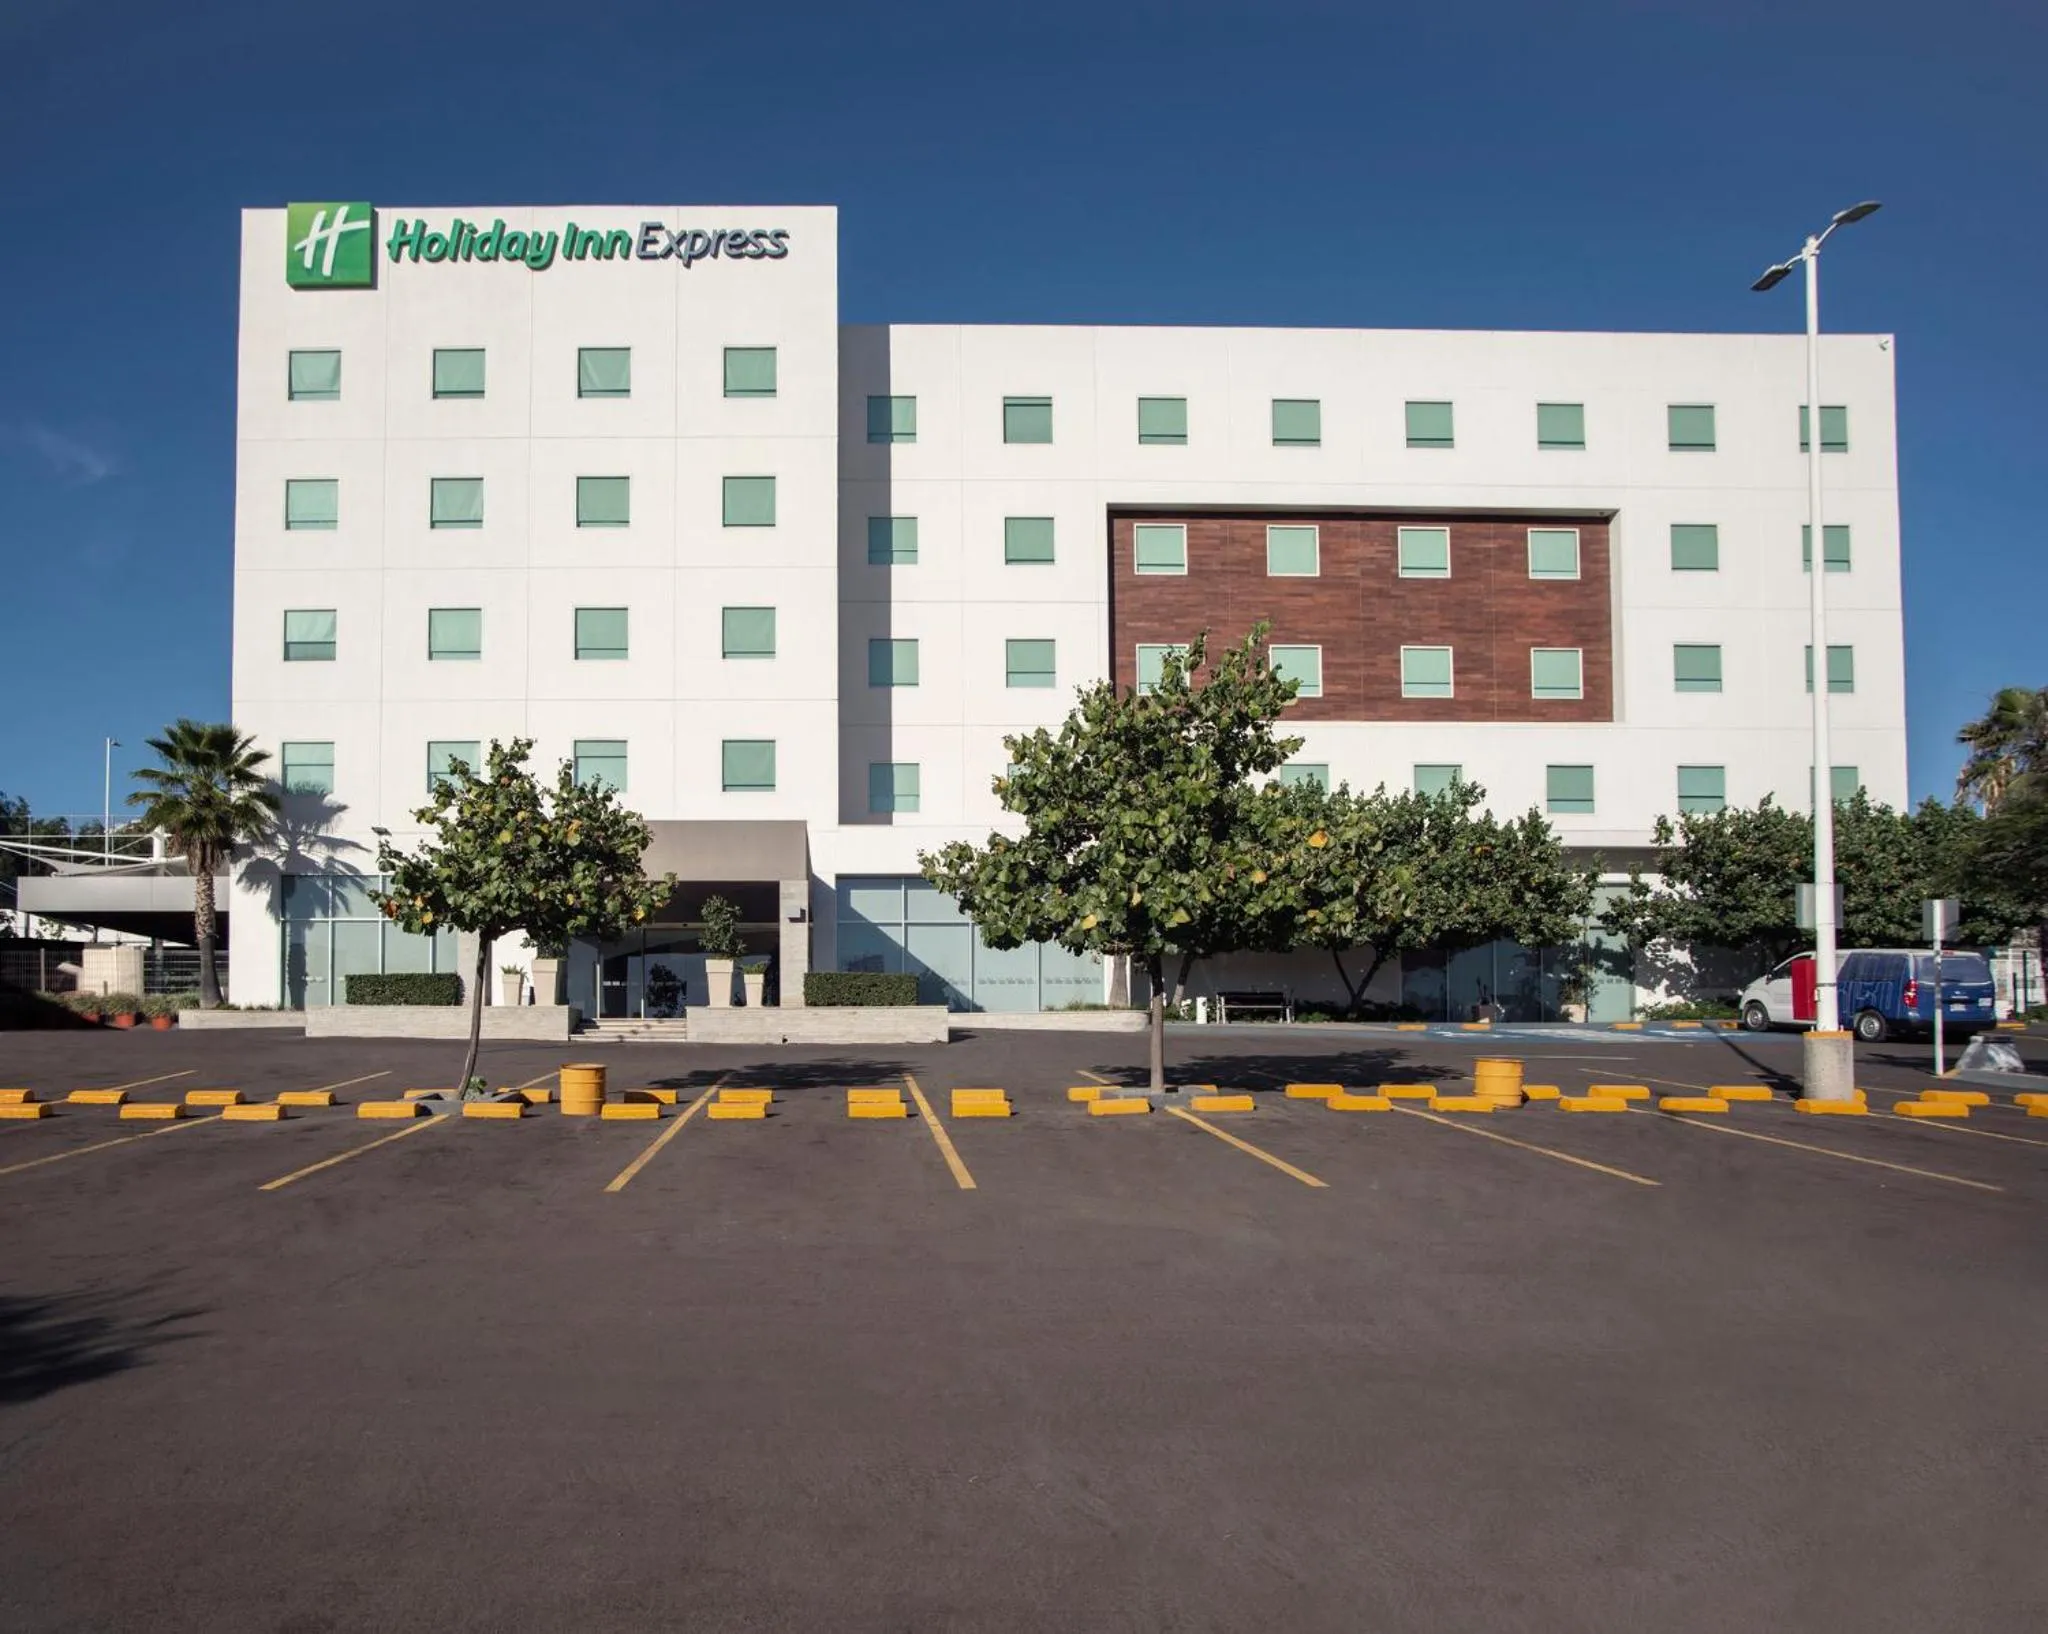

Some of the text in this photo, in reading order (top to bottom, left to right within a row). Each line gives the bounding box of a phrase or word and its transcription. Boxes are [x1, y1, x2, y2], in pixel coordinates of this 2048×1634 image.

[388, 219, 788, 270] Holiday Inn Express
